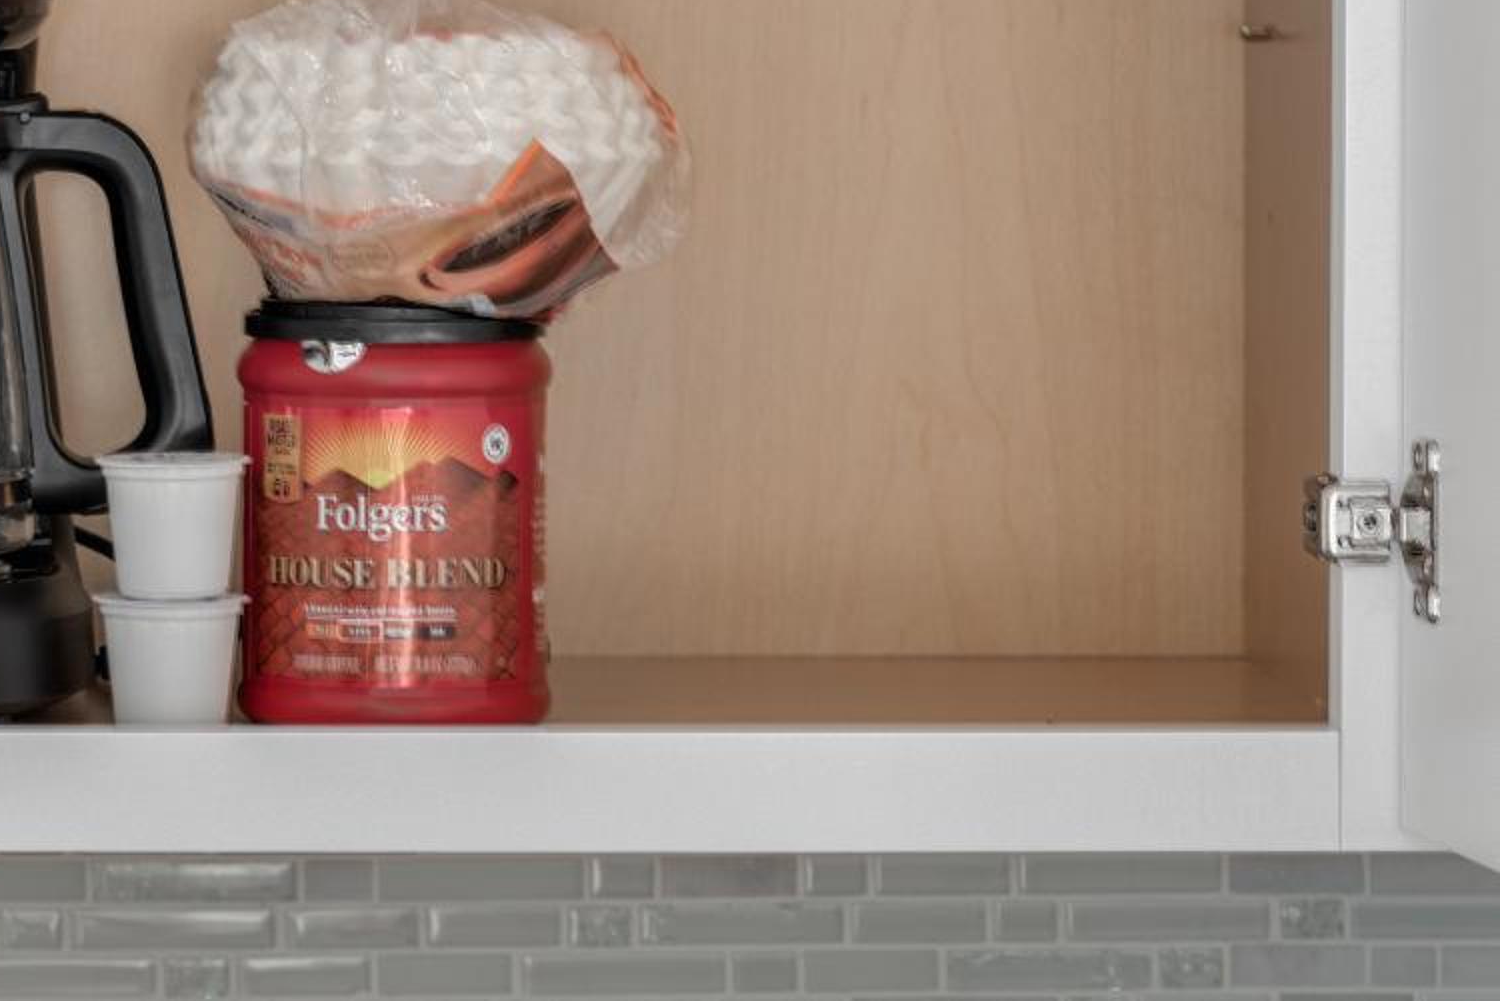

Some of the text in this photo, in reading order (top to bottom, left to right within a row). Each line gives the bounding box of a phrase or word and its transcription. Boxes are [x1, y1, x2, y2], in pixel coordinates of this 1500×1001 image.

[317, 493, 448, 541] Folgers
[269, 556, 507, 589] HOUSE BLEND
